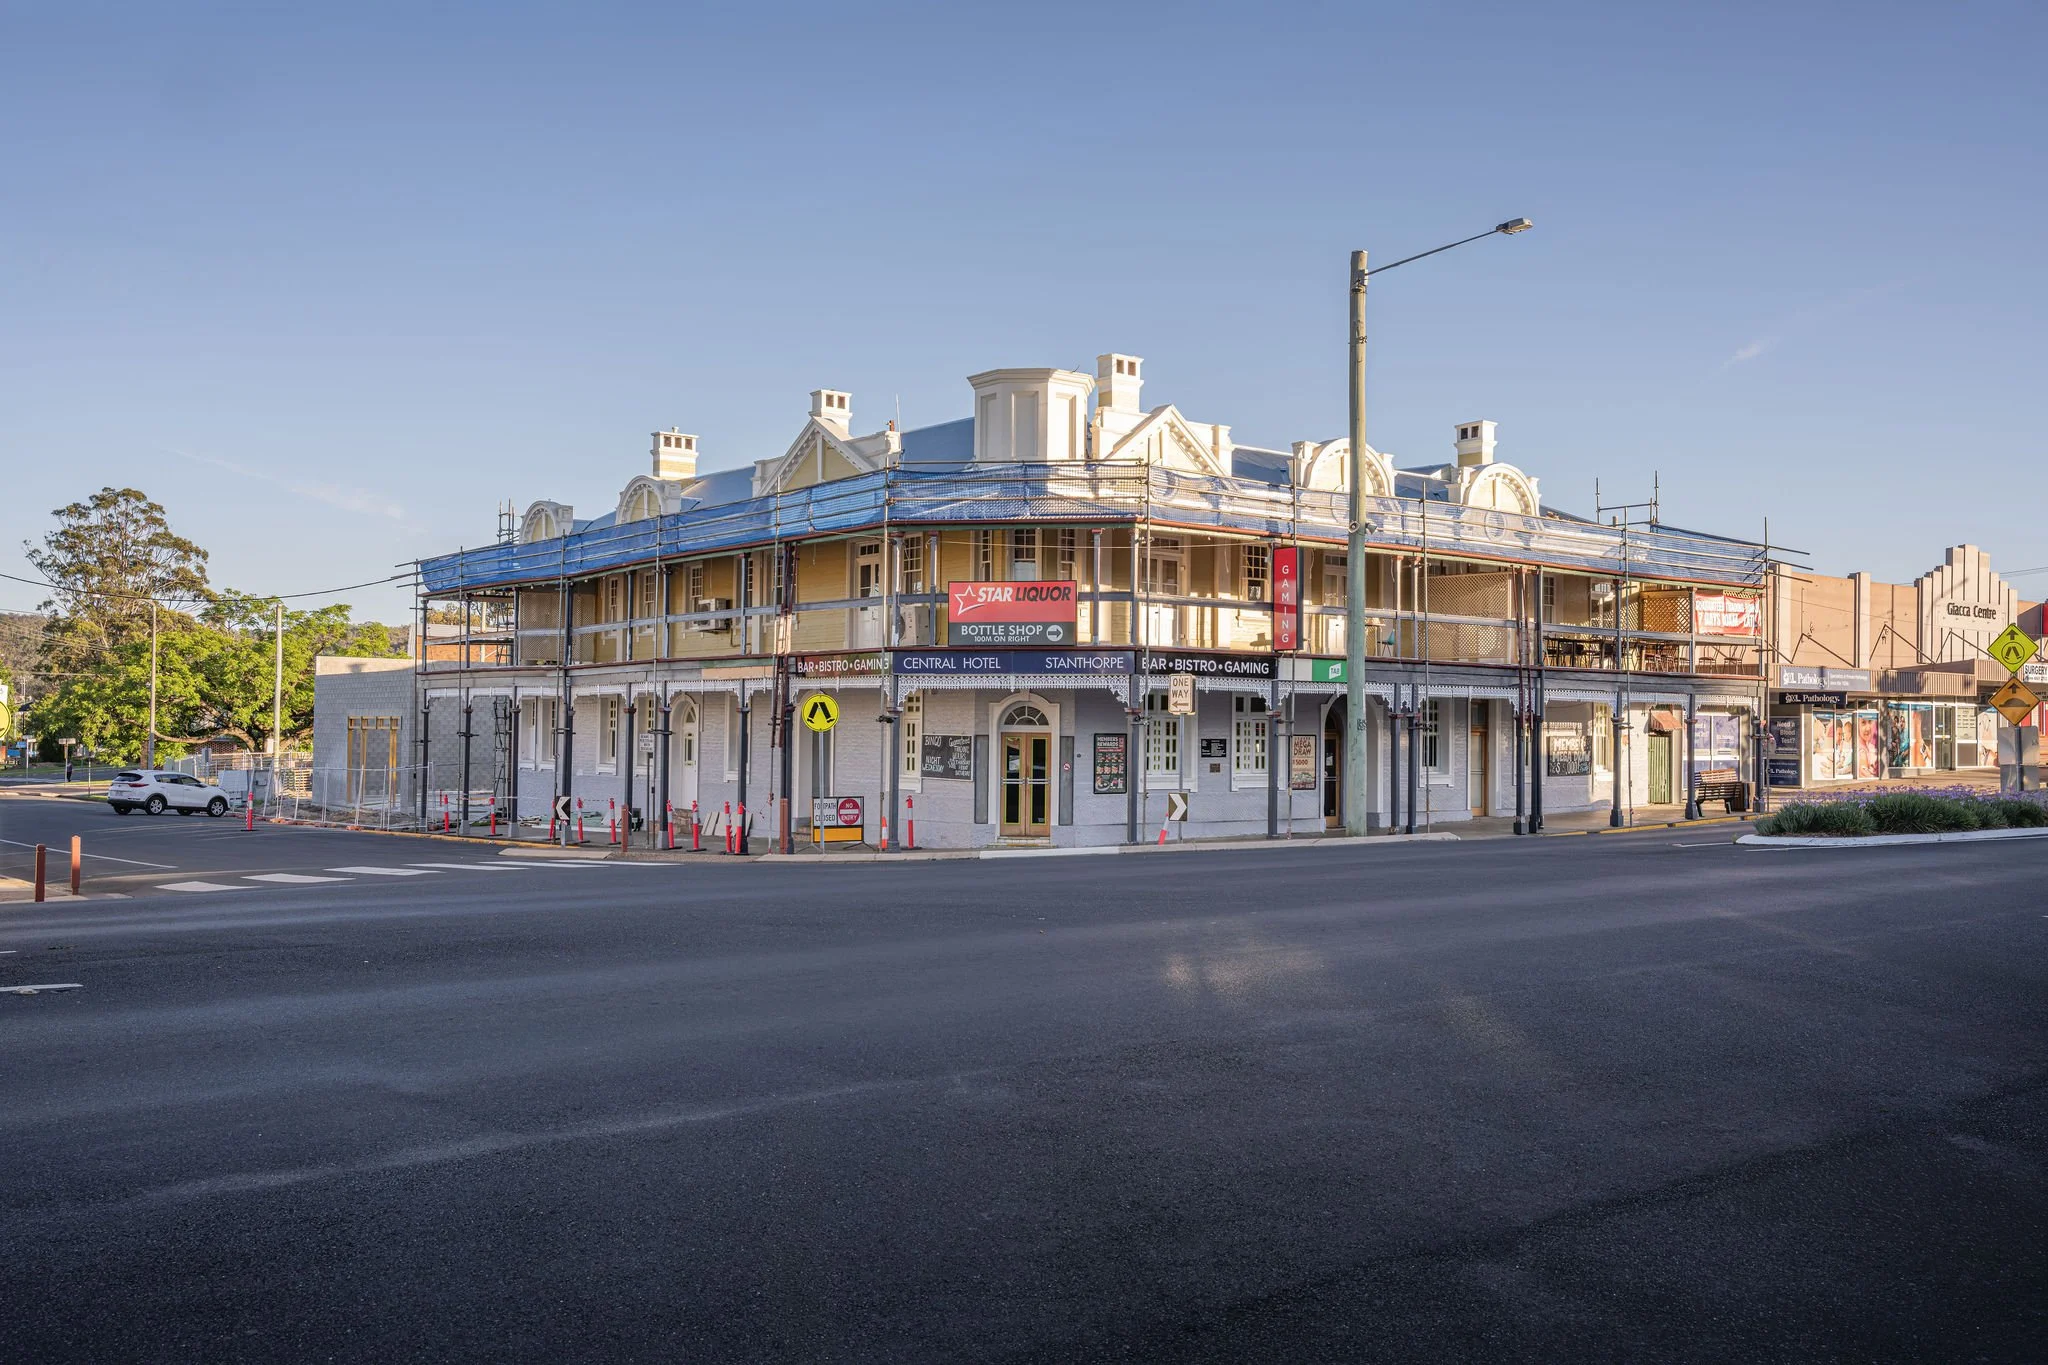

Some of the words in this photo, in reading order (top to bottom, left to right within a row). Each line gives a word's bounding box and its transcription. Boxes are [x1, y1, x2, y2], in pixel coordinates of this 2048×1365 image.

[977, 587, 1013, 602] STAR
[1015, 586, 1071, 602] LIQUOR
[1281, 565, 1289, 643] GAMING
[1947, 602, 1971, 616] Giacca
[1973, 605, 1996, 619] Centre
[961, 625, 1005, 636] BOTTLE
[1009, 625, 1043, 636] SHOP
[798, 662, 814, 673] BAR
[819, 660, 848, 672] BISTRO
[854, 658, 889, 671] GAMING
[903, 657, 956, 669] CENTRAL
[963, 657, 1001, 669] HOTEL
[1045, 657, 1124, 669] STANTHORPE
[1141, 658, 1166, 670] BAR
[1174, 659, 1217, 672] BISTRO
[1224, 662, 1269, 674] GAMING
[2025, 664, 2047, 676] SURGERY
[1172, 678, 1189, 687] ONE
[1171, 689, 1189, 698] WAY
[1803, 694, 1840, 704] Pathology.
[924, 736, 942, 747] BINGO
[1294, 740, 1311, 748] MEGA
[925, 756, 942, 765] NIGHT
